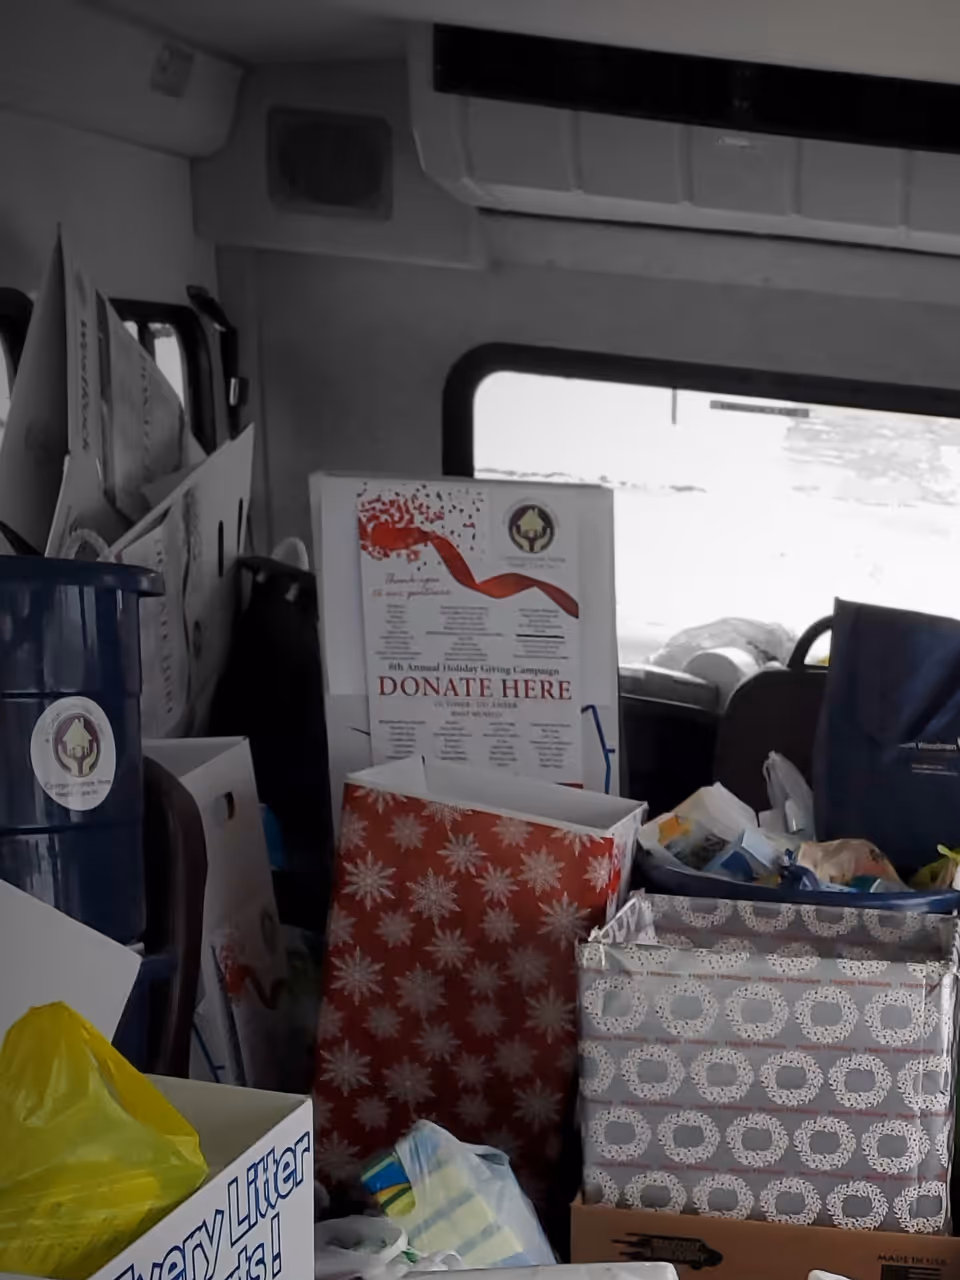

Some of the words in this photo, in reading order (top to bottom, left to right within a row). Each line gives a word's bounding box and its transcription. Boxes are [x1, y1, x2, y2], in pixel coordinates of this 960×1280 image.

[378, 675, 493, 698] DONATE
[501, 679, 573, 701] HERE
[227, 1131, 310, 1249] Litter
